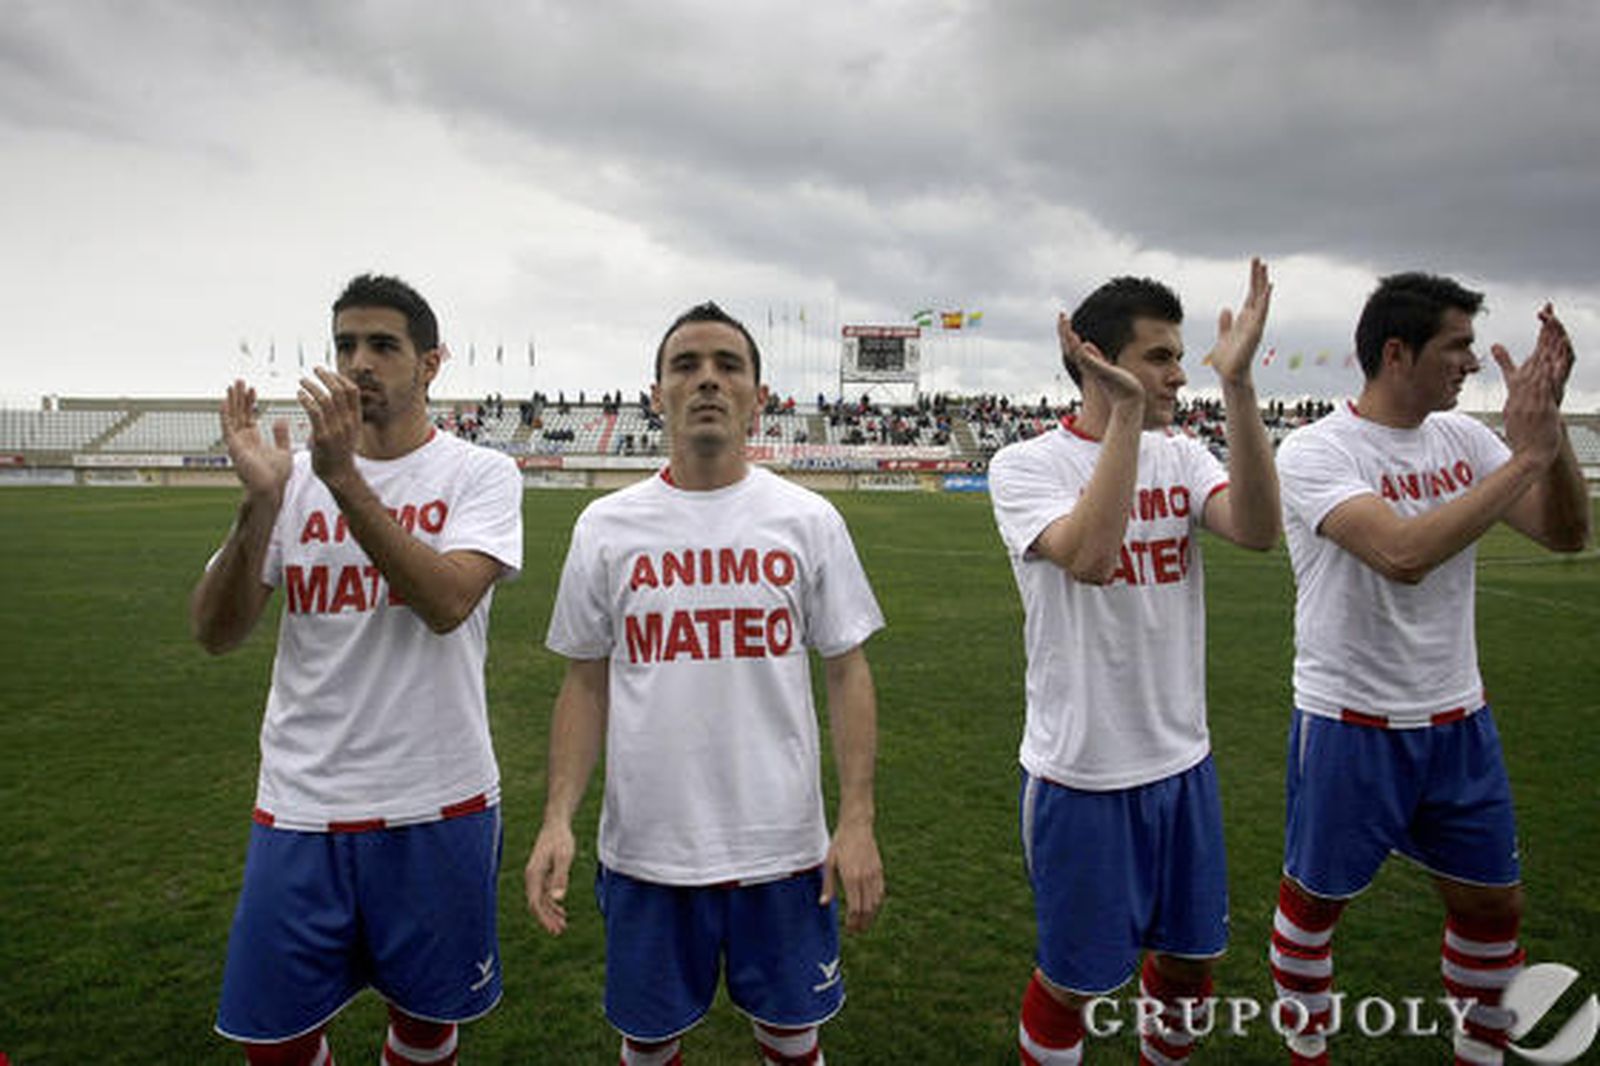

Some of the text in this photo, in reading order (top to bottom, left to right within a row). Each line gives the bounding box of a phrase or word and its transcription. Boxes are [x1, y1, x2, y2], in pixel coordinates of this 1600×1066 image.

[1379, 459, 1473, 502] ANIMO
[630, 548, 796, 592] ANIMO
[625, 607, 793, 664] MATEO
